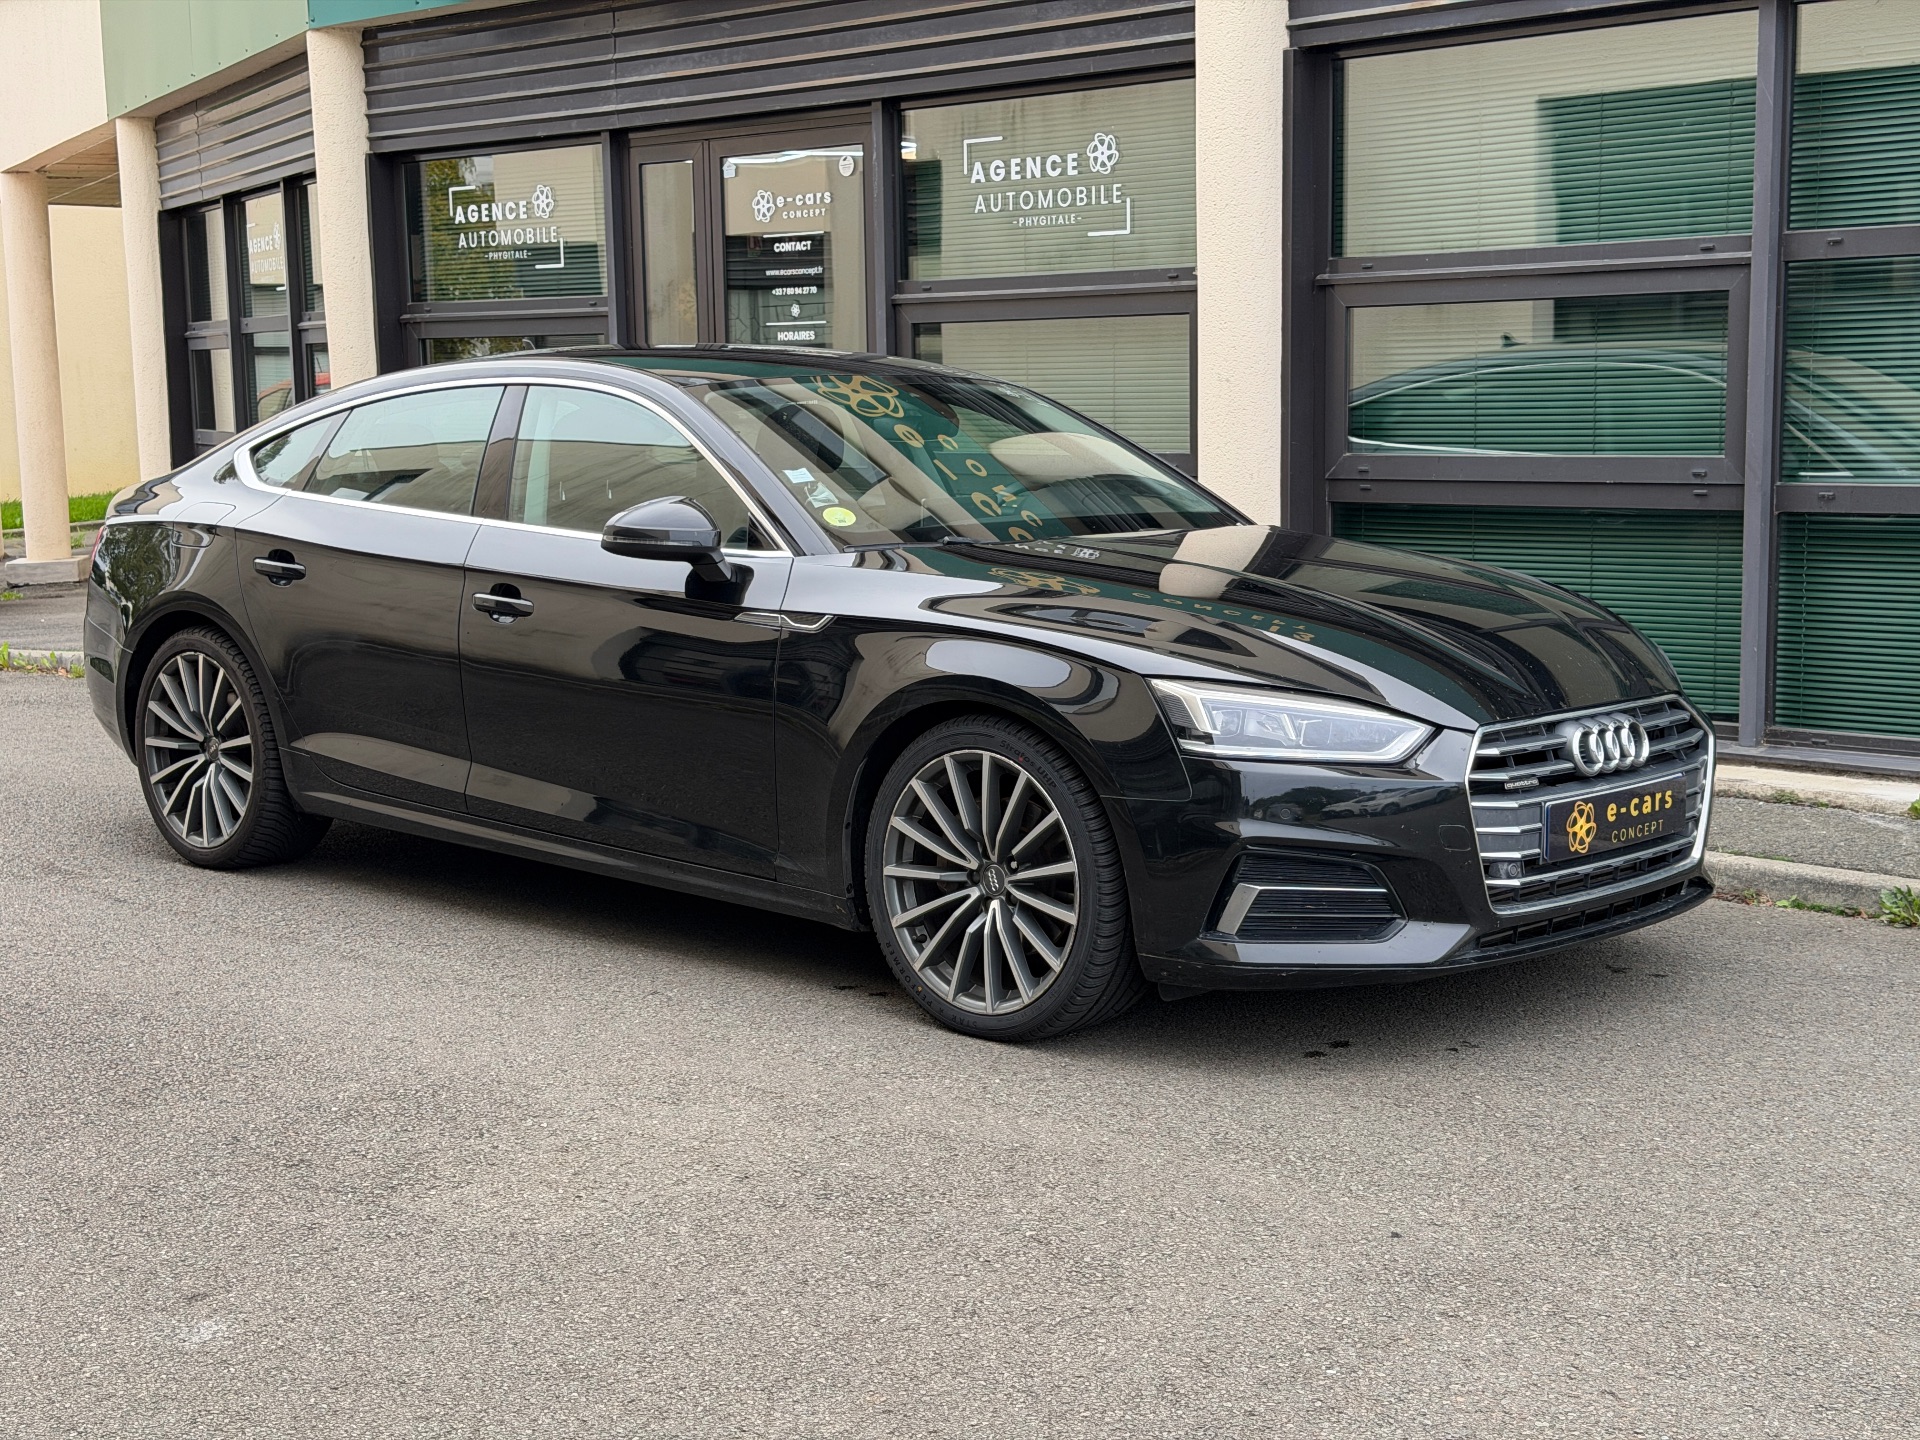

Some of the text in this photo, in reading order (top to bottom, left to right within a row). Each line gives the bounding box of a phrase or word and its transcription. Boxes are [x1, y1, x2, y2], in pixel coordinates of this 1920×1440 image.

[971, 153, 1078, 183] AGENCE
[776, 192, 831, 207] e-cars
[974, 184, 1122, 213] AUTOMOBILE
[455, 201, 527, 224] AGENCE
[782, 208, 826, 219] CONCEPT
[249, 236, 273, 254] AGENCE
[458, 226, 558, 248] AUTOMOBILE
[773, 241, 812, 252] CONTACT
[251, 256, 284, 273] AUTOMOBILE
[777, 331, 816, 341] HORAIRES
[1506, 779, 1538, 789] quattro
[1607, 790, 1672, 822] e-cars
[1611, 819, 1664, 843] CONCEPT
